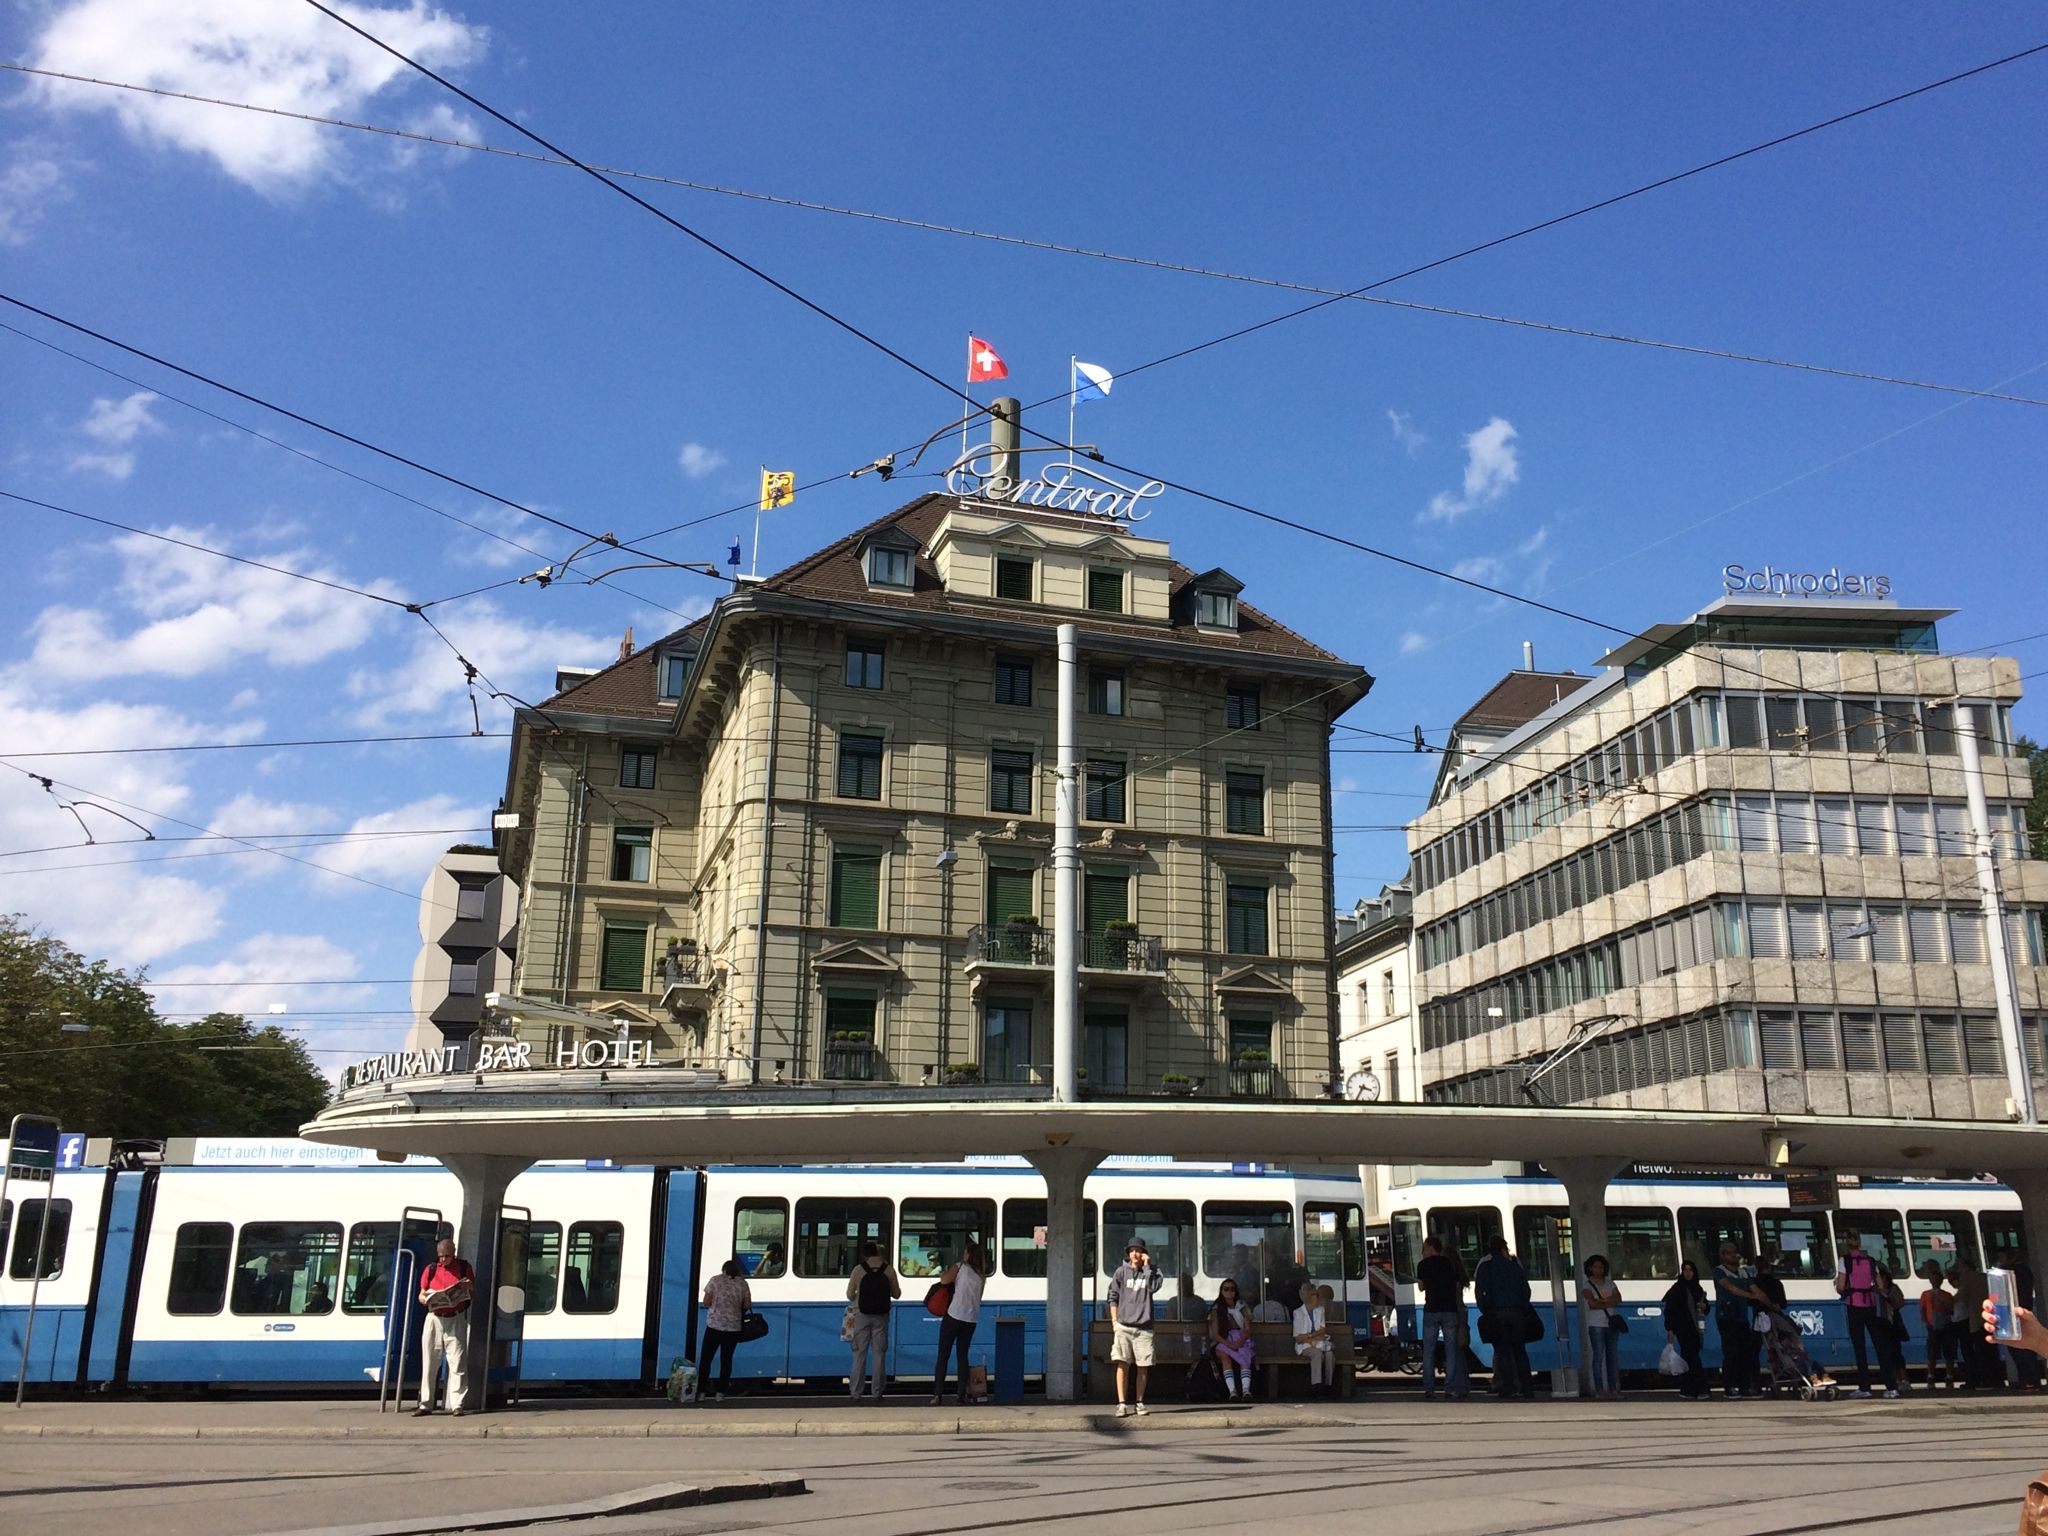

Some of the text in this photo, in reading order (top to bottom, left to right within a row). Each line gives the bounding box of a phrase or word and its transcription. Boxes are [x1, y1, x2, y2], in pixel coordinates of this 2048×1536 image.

[946, 443, 1164, 521] Central
[1723, 564, 1892, 595] Schroders
[354, 1046, 460, 1086] RESTAURANT
[477, 1043, 531, 1070] BAR
[556, 1040, 660, 1067] HOTEL
[201, 1145, 221, 1159] Jetzt
[235, 1145, 266, 1159] auch
[270, 1145, 295, 1159] hier
